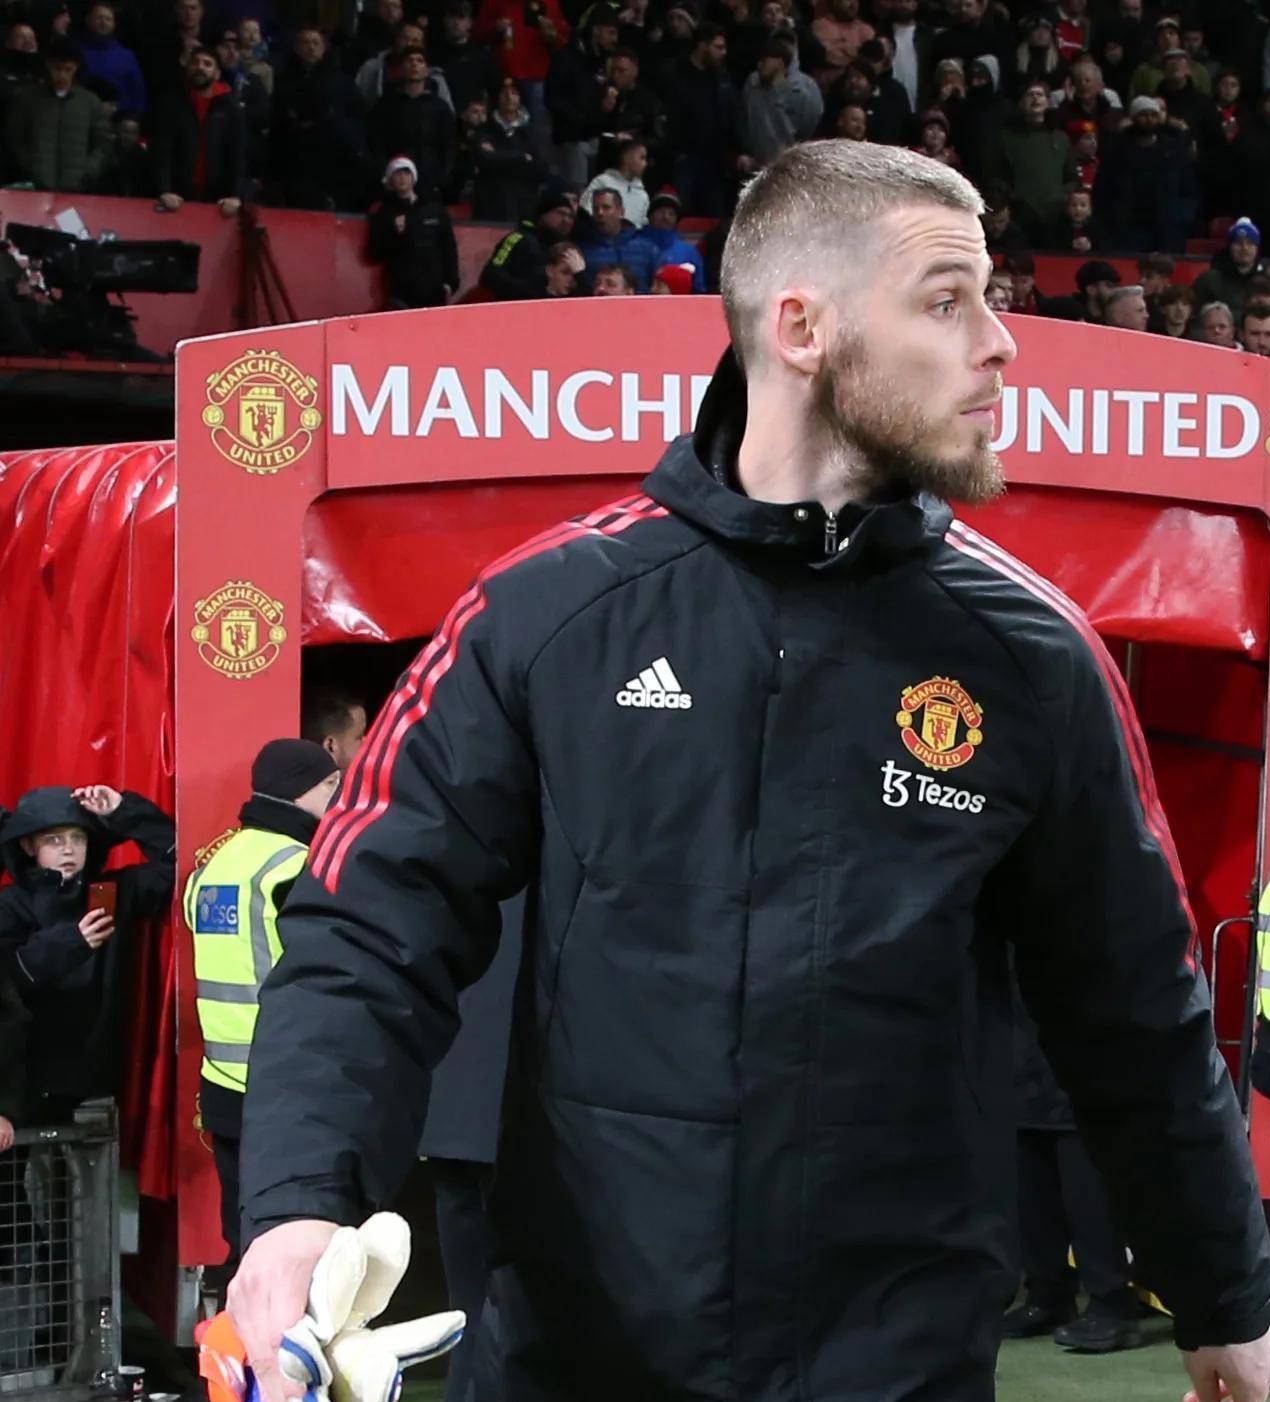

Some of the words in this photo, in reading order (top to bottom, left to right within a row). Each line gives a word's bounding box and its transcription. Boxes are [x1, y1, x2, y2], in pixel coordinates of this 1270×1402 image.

[215, 359, 309, 400] MANCHESTER
[230, 443, 295, 466] UNITED
[201, 587, 278, 620] MANCHESTER
[213, 654, 266, 672] UNITED
[616, 689, 692, 709] adidas
[907, 683, 977, 722] MANCHESTER
[914, 743, 961, 766] UNITED
[915, 773, 986, 814] Tezos
